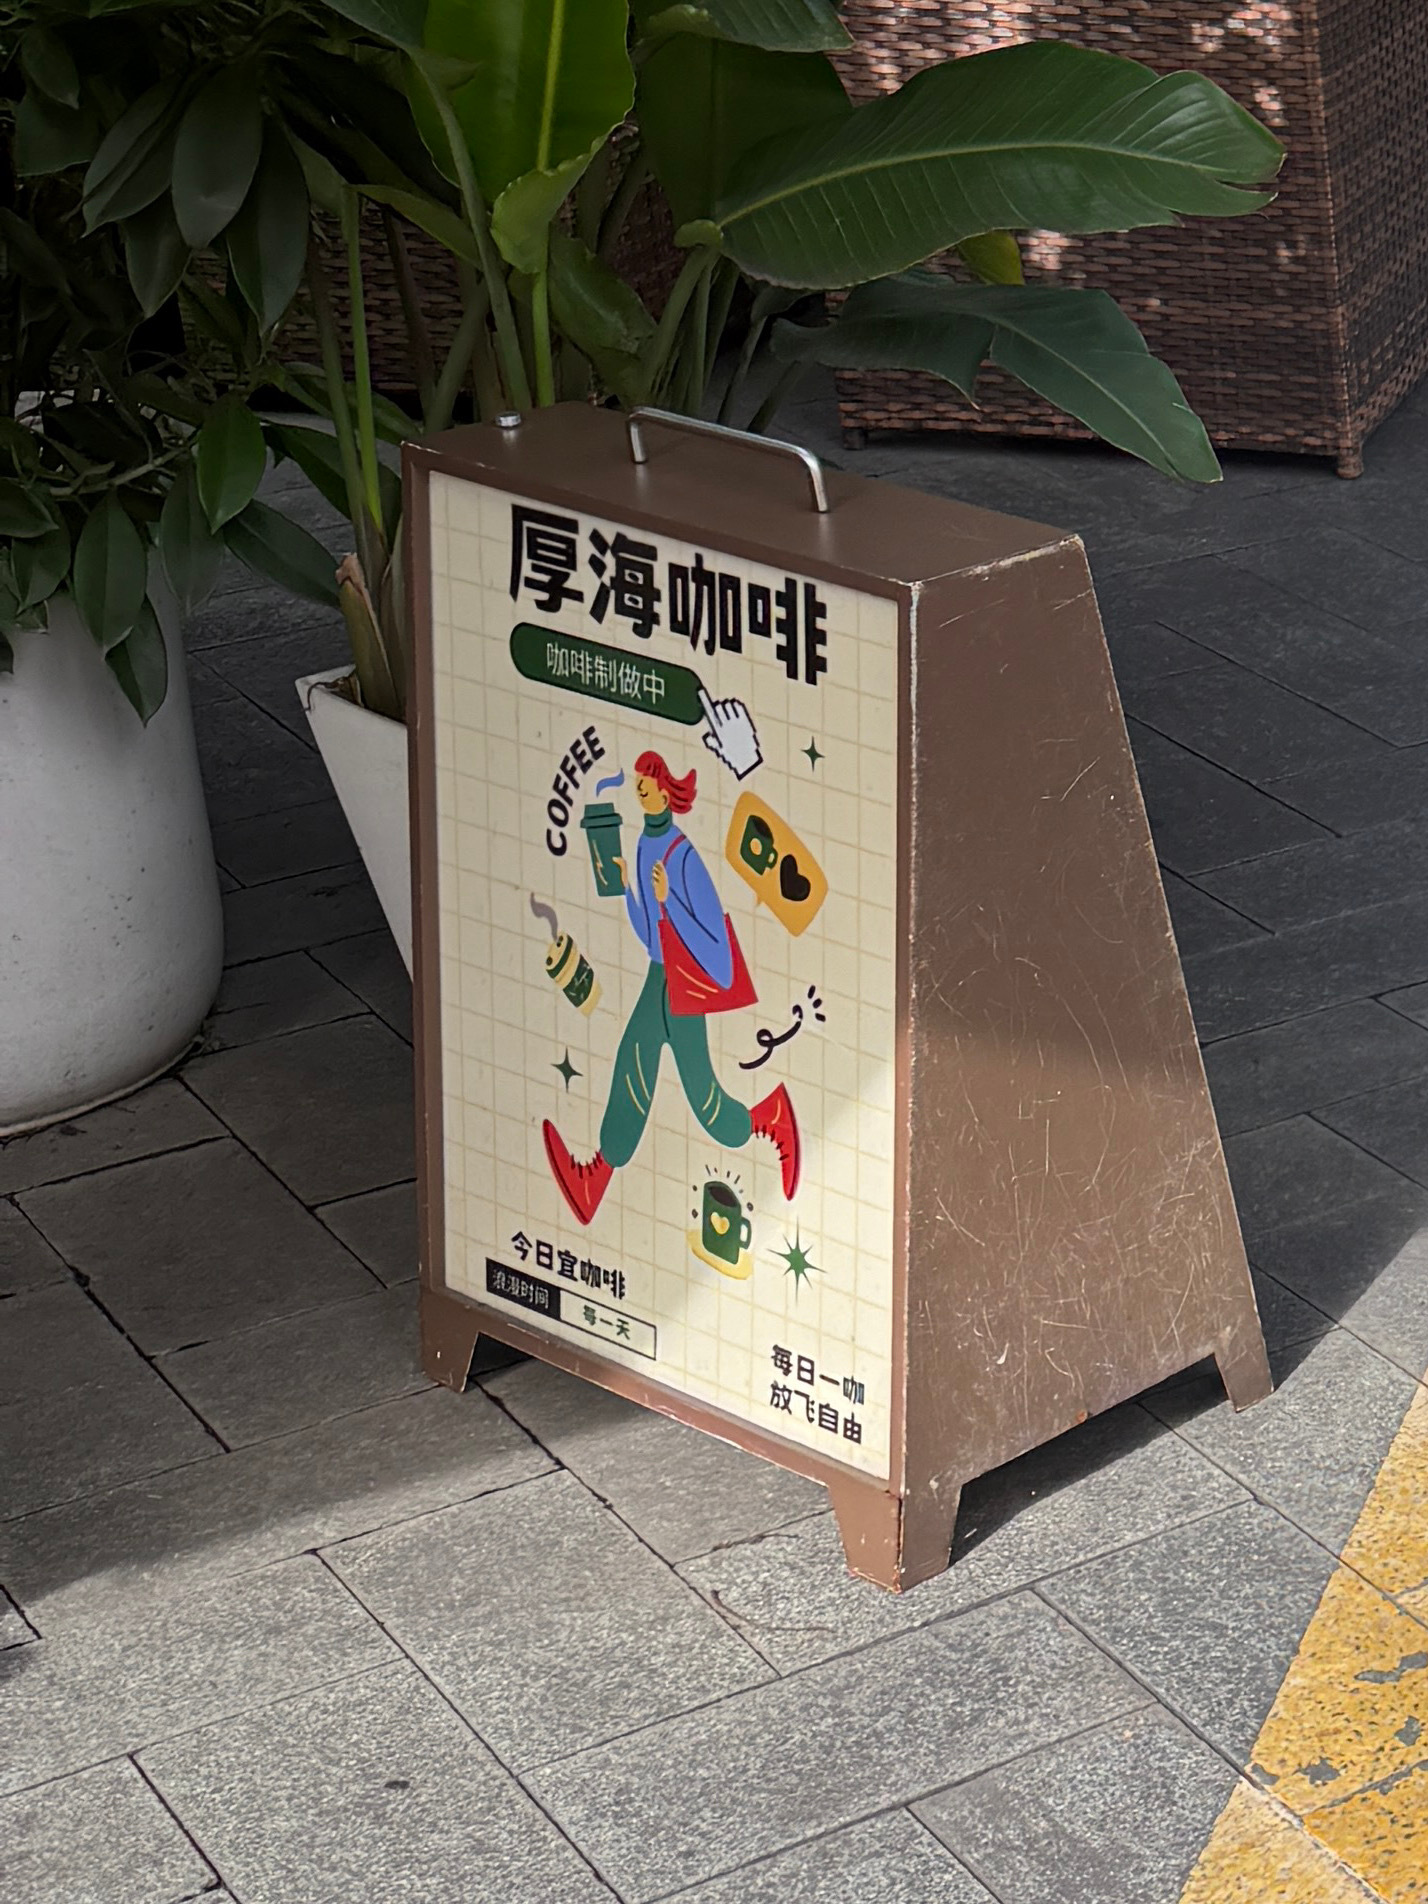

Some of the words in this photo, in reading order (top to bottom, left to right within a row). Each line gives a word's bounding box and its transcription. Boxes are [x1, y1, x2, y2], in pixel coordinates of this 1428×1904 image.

[508, 503, 828, 686] 厚海咖啡
[546, 641, 666, 705] 咖啡制做中
[546, 725, 606, 857] COFFEE
[511, 1231, 626, 1300] 今日宜咖啡
[583, 1304, 631, 1341] 每一天
[770, 1344, 865, 1405] 每日一咖
[770, 1380, 862, 1445] 放飞自由
